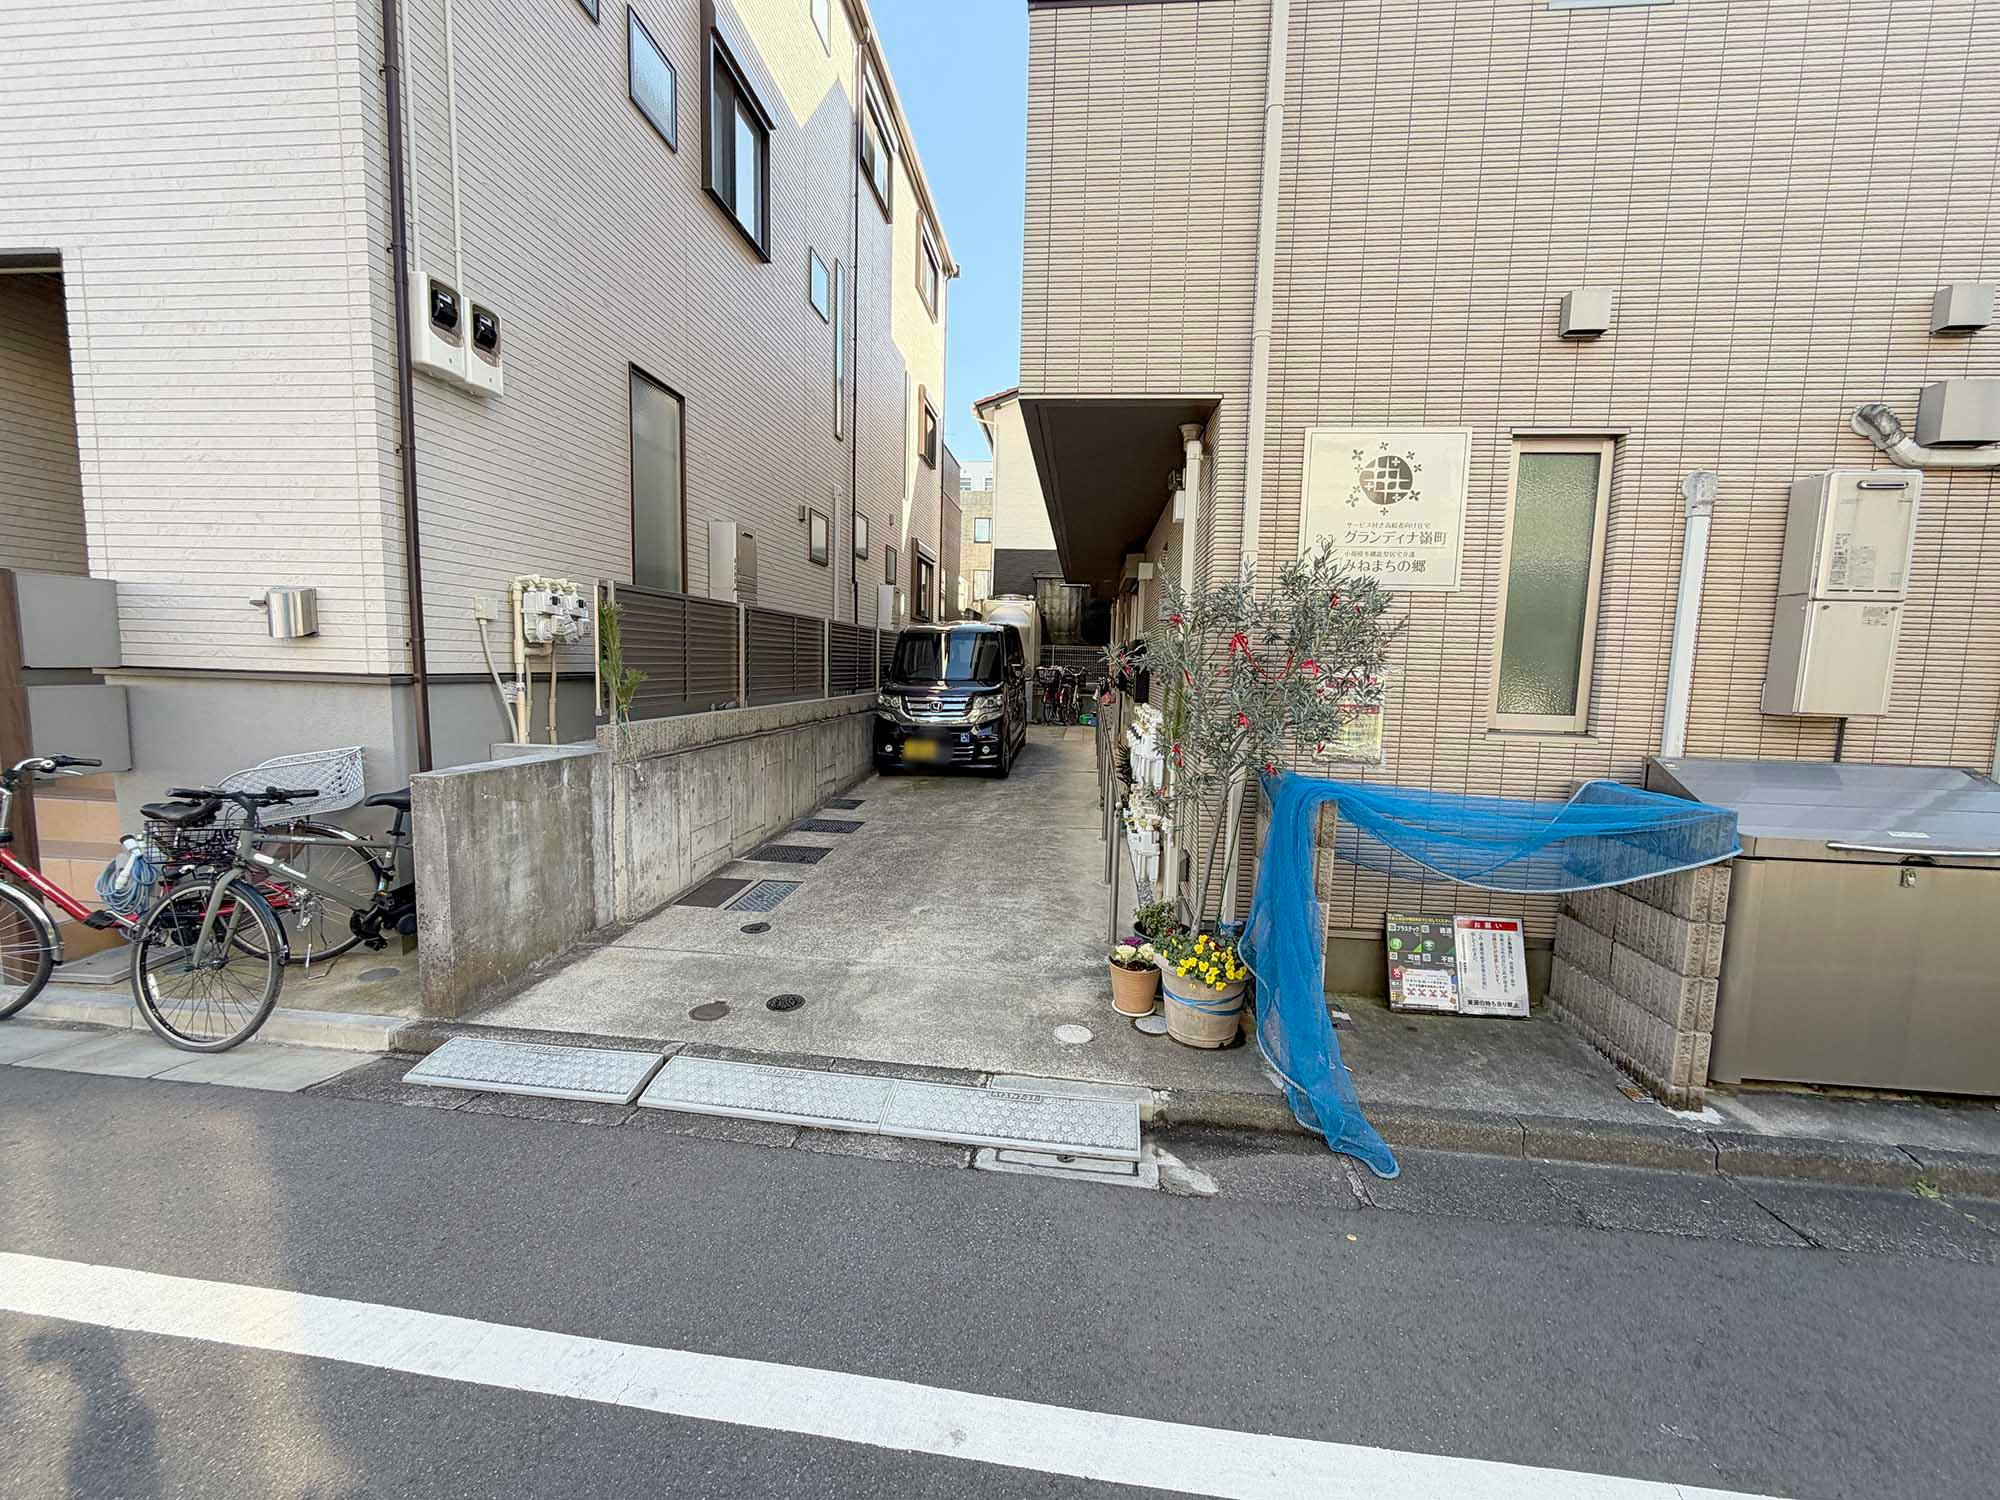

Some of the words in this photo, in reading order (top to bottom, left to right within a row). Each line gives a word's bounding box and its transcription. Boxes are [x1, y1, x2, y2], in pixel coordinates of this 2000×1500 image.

[1344, 530, 1448, 545] グランディナ嶺町
[1344, 559, 1426, 573] みねまちの郷
[1396, 925, 1420, 933] プラスチック
